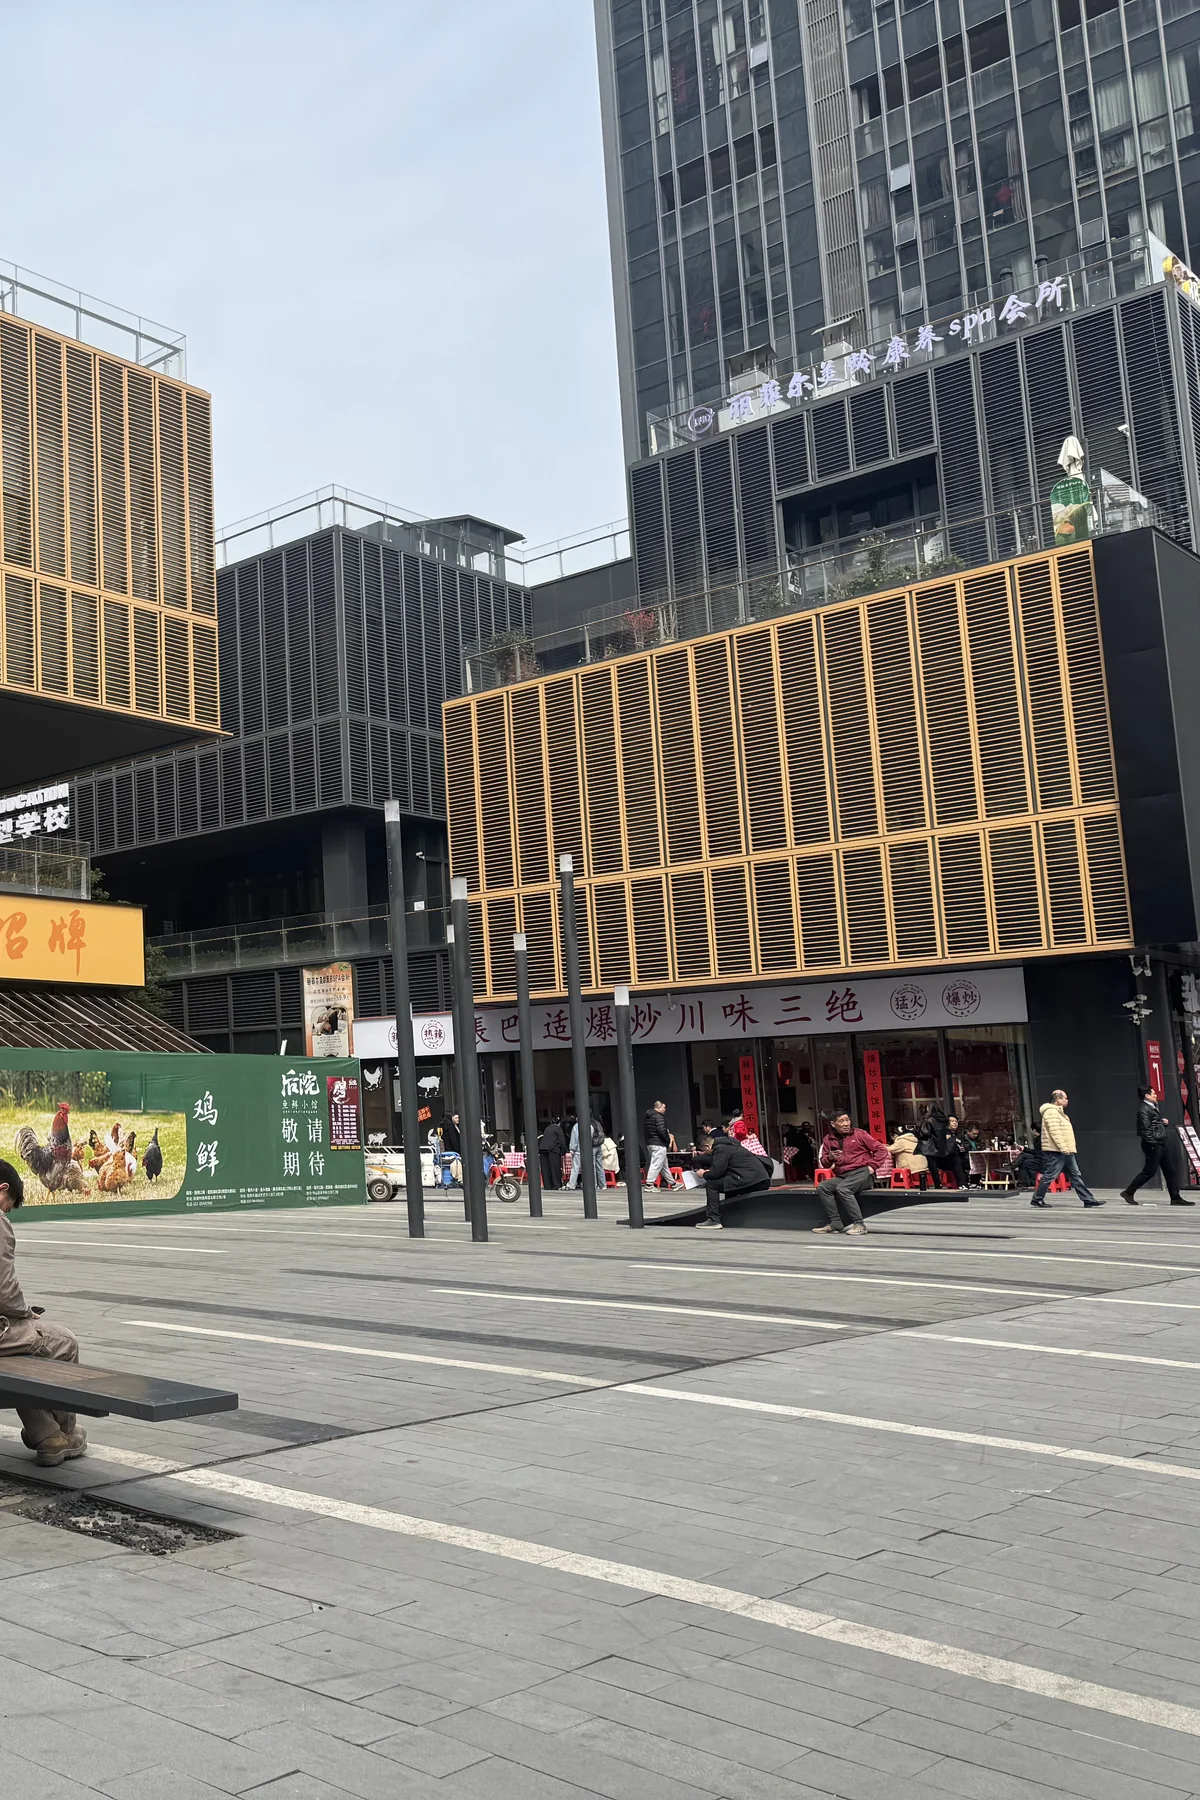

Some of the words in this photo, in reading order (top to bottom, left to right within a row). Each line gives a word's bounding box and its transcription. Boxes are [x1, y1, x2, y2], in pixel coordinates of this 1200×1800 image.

[893, 994, 924, 1010] 猛火
[945, 991, 977, 1006] 爆炒
[281, 1068, 320, 1097] 后院
[282, 1099, 318, 1110] 鱼鲜小馆
[192, 1090, 221, 1178] 鸡鲜
[281, 1117, 323, 1144] 敬请
[283, 1151, 325, 1177] 期待
